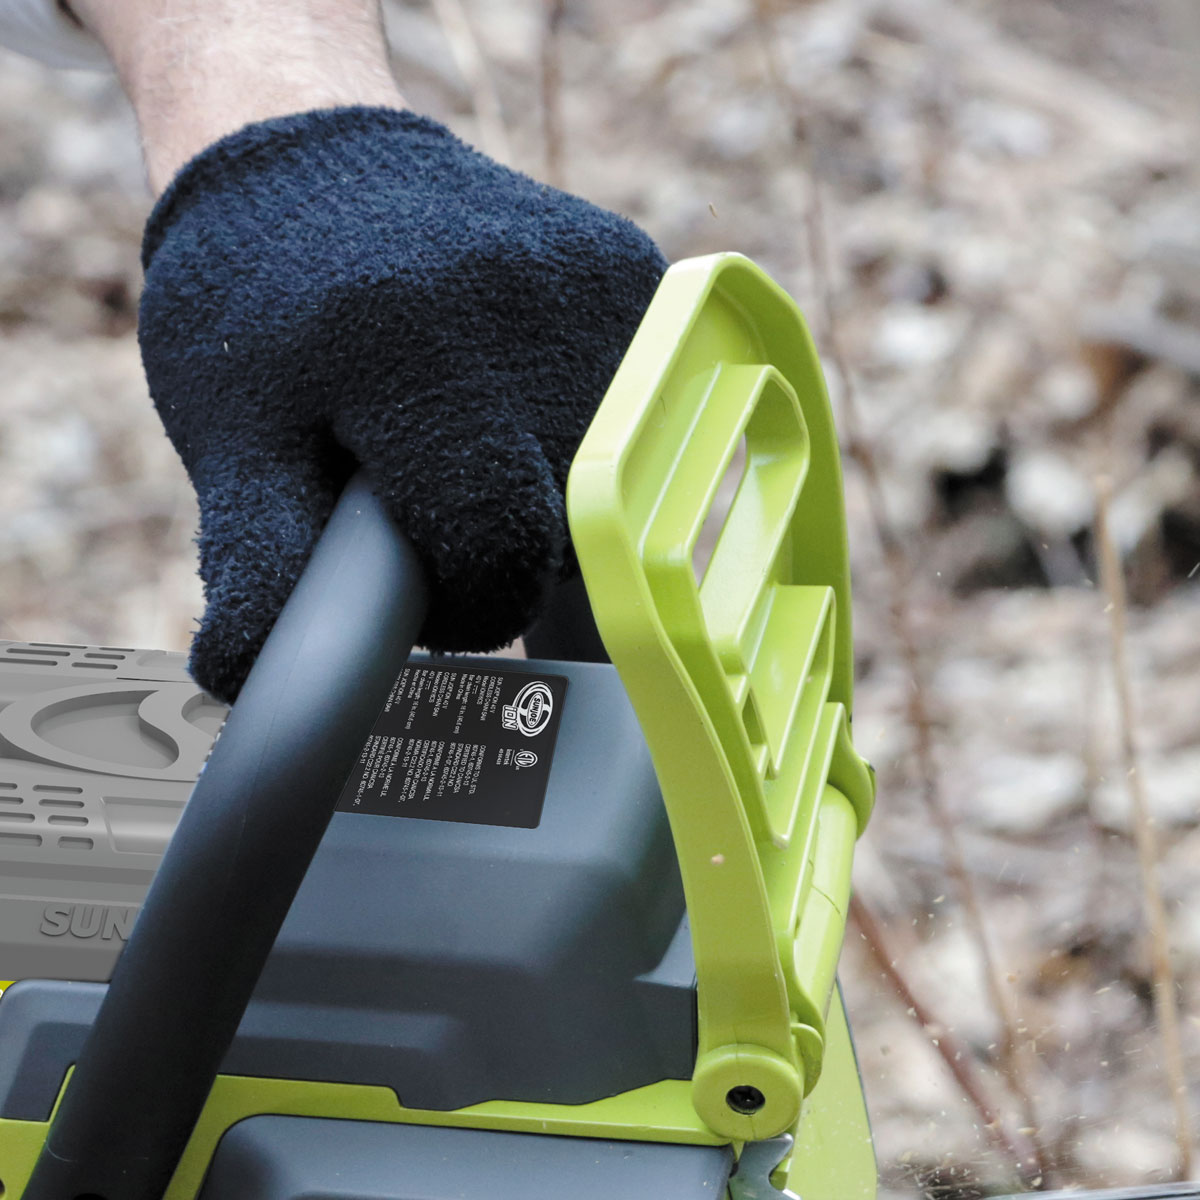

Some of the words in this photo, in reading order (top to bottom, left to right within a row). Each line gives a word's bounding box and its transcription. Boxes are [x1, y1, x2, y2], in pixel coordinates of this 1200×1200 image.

[449, 672, 457, 681] SUN
[496, 676, 504, 685] SUN
[527, 697, 541, 722] SUNJOE
